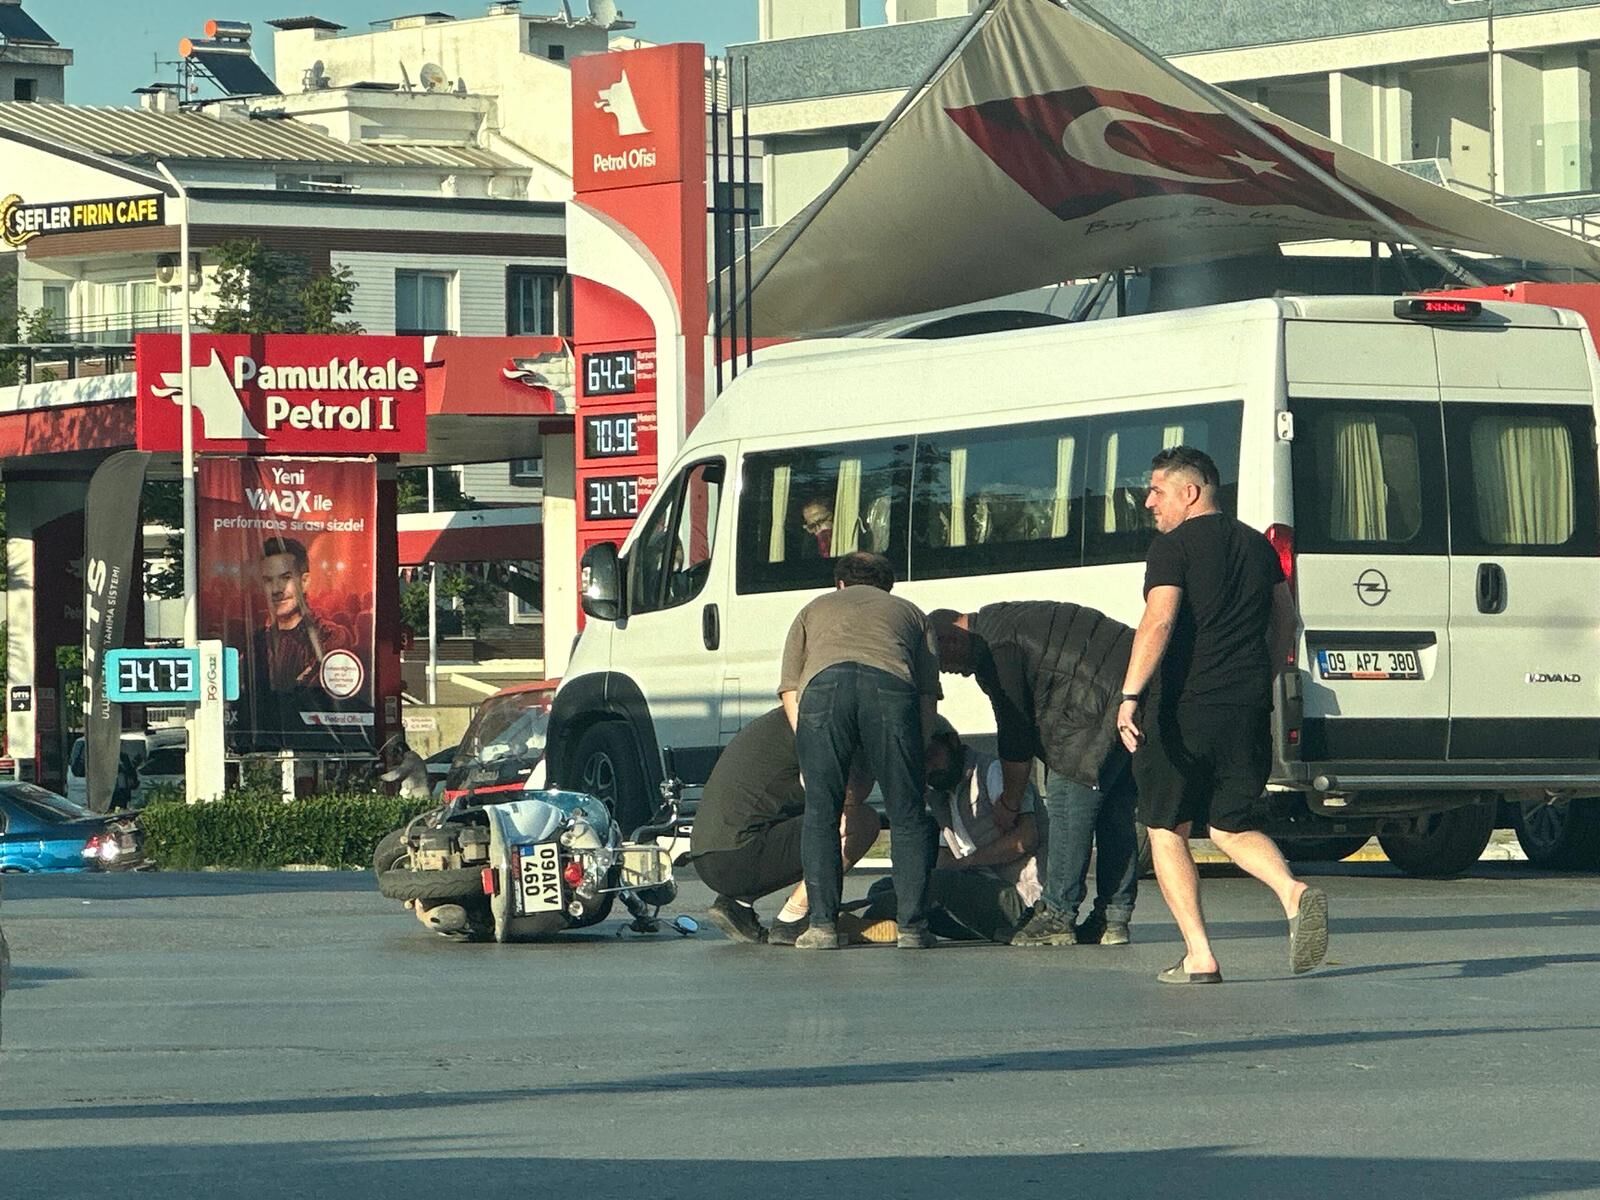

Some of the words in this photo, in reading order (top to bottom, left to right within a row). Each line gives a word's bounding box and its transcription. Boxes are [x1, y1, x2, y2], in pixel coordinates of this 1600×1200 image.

[593, 151, 627, 173] Petrol
[628, 147, 656, 168] Ofisi
[73, 202, 113, 227] FIRIN
[116, 198, 158, 223] CAFE
[233, 356, 419, 391] Pamukkale
[266, 396, 371, 430] Petrol
[272, 467, 305, 485] Yeni
[313, 495, 333, 511] ile
[590, 481, 638, 515] 34.73
[213, 515, 287, 532] performans
[326, 518, 365, 532] sizde!
[1327, 653, 1347, 672] 09
[1356, 653, 1382, 672] APZ
[1388, 653, 1416, 672] 380
[523, 861, 541, 897] 460
